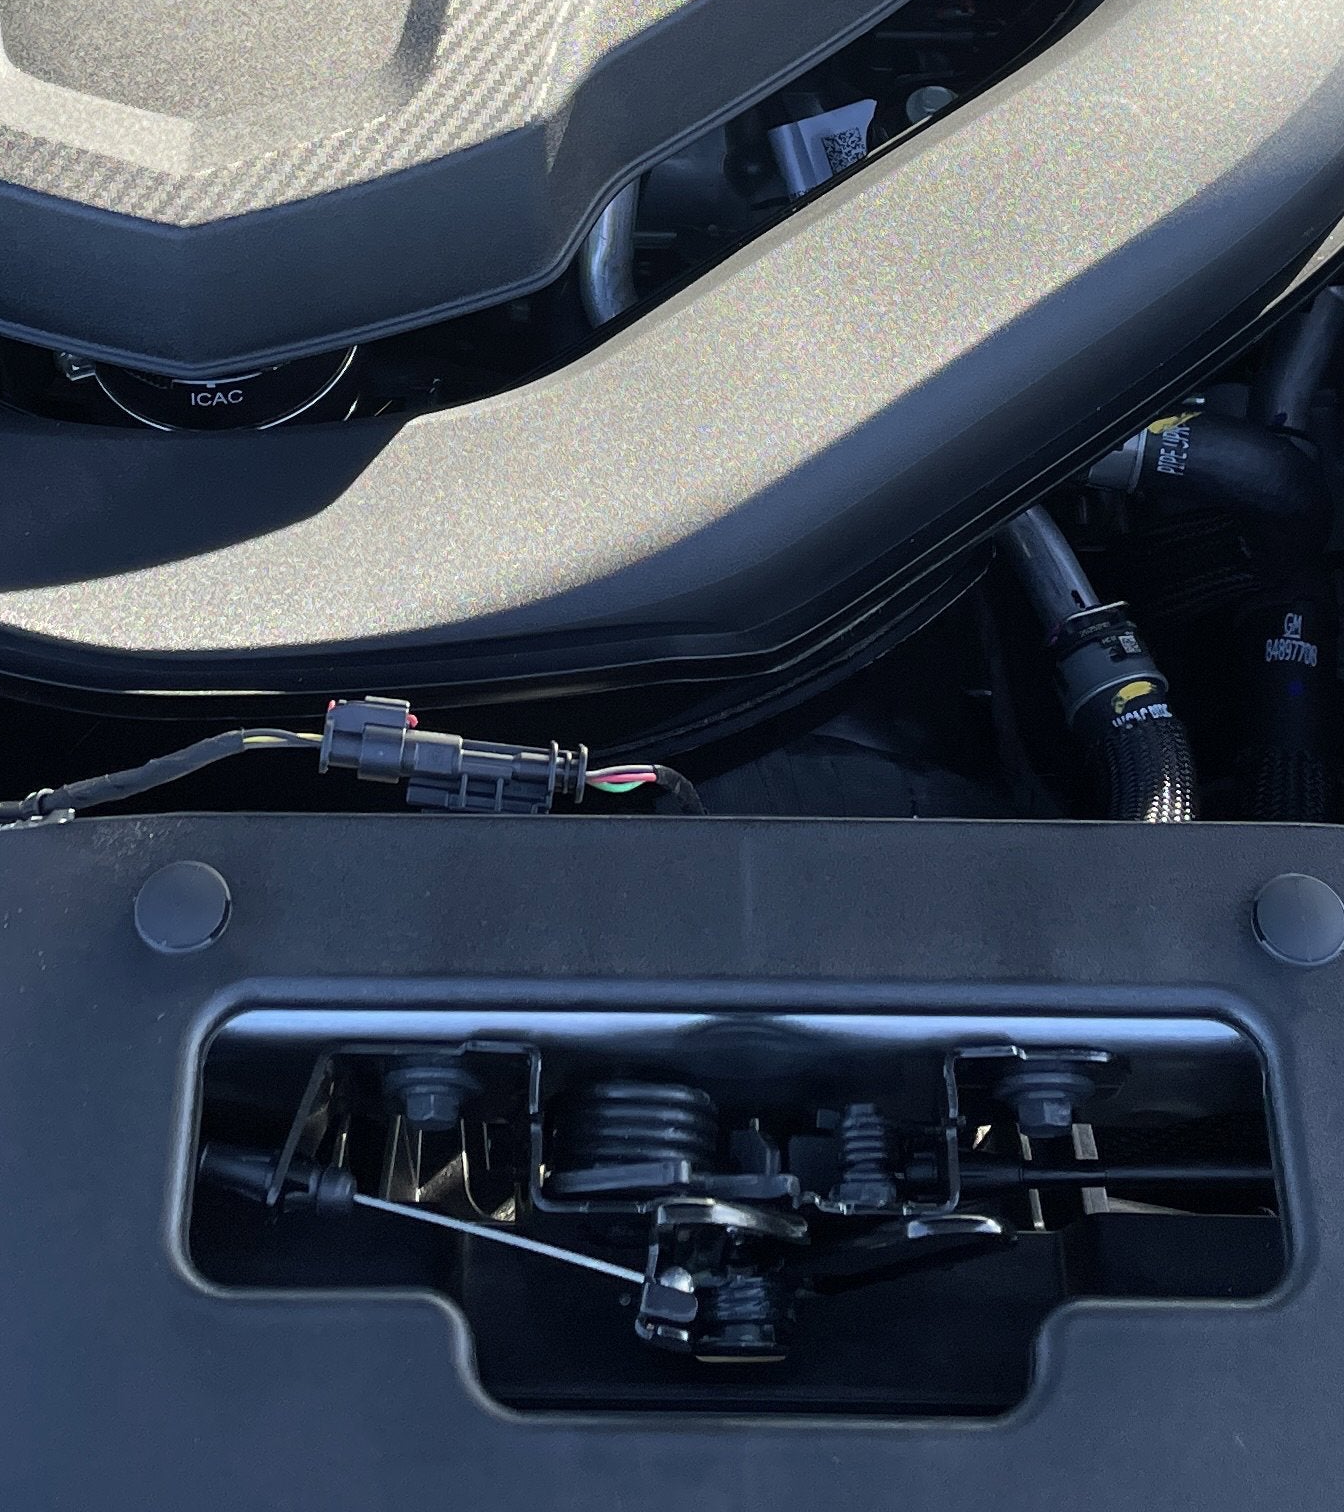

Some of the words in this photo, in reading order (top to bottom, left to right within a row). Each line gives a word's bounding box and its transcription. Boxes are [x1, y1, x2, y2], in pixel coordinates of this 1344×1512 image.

[190, 390, 244, 406] ICAC
[1157, 448, 1188, 476] PIPE
[1283, 612, 1302, 637] GM
